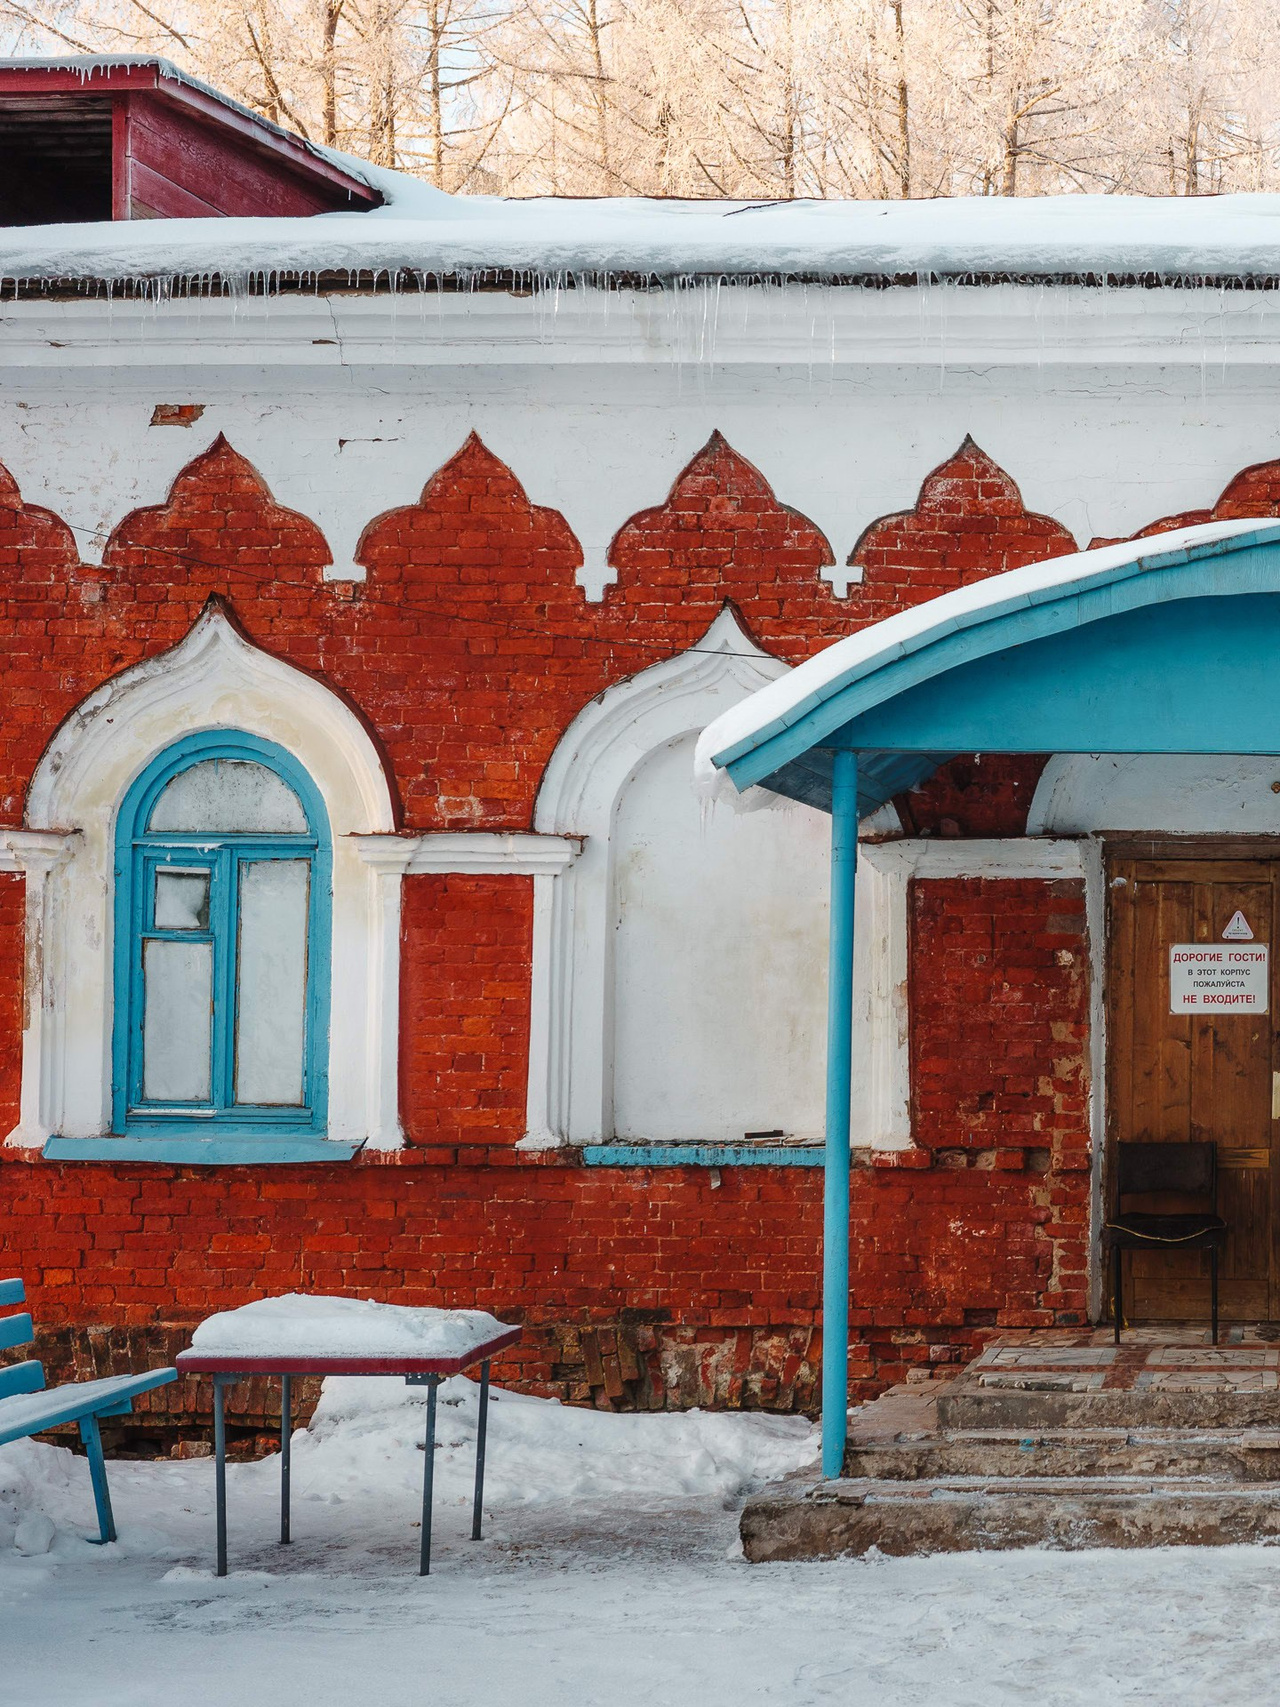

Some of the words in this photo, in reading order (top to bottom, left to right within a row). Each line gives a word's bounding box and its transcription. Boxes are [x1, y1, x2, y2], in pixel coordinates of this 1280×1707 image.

[1173, 953, 1223, 963] ДОРОГИЕ
[1228, 953, 1266, 962] ГОСТИ!
[1183, 994, 1197, 1003] НЕ
[1203, 994, 1256, 1005] ВХОДИТЕ!
